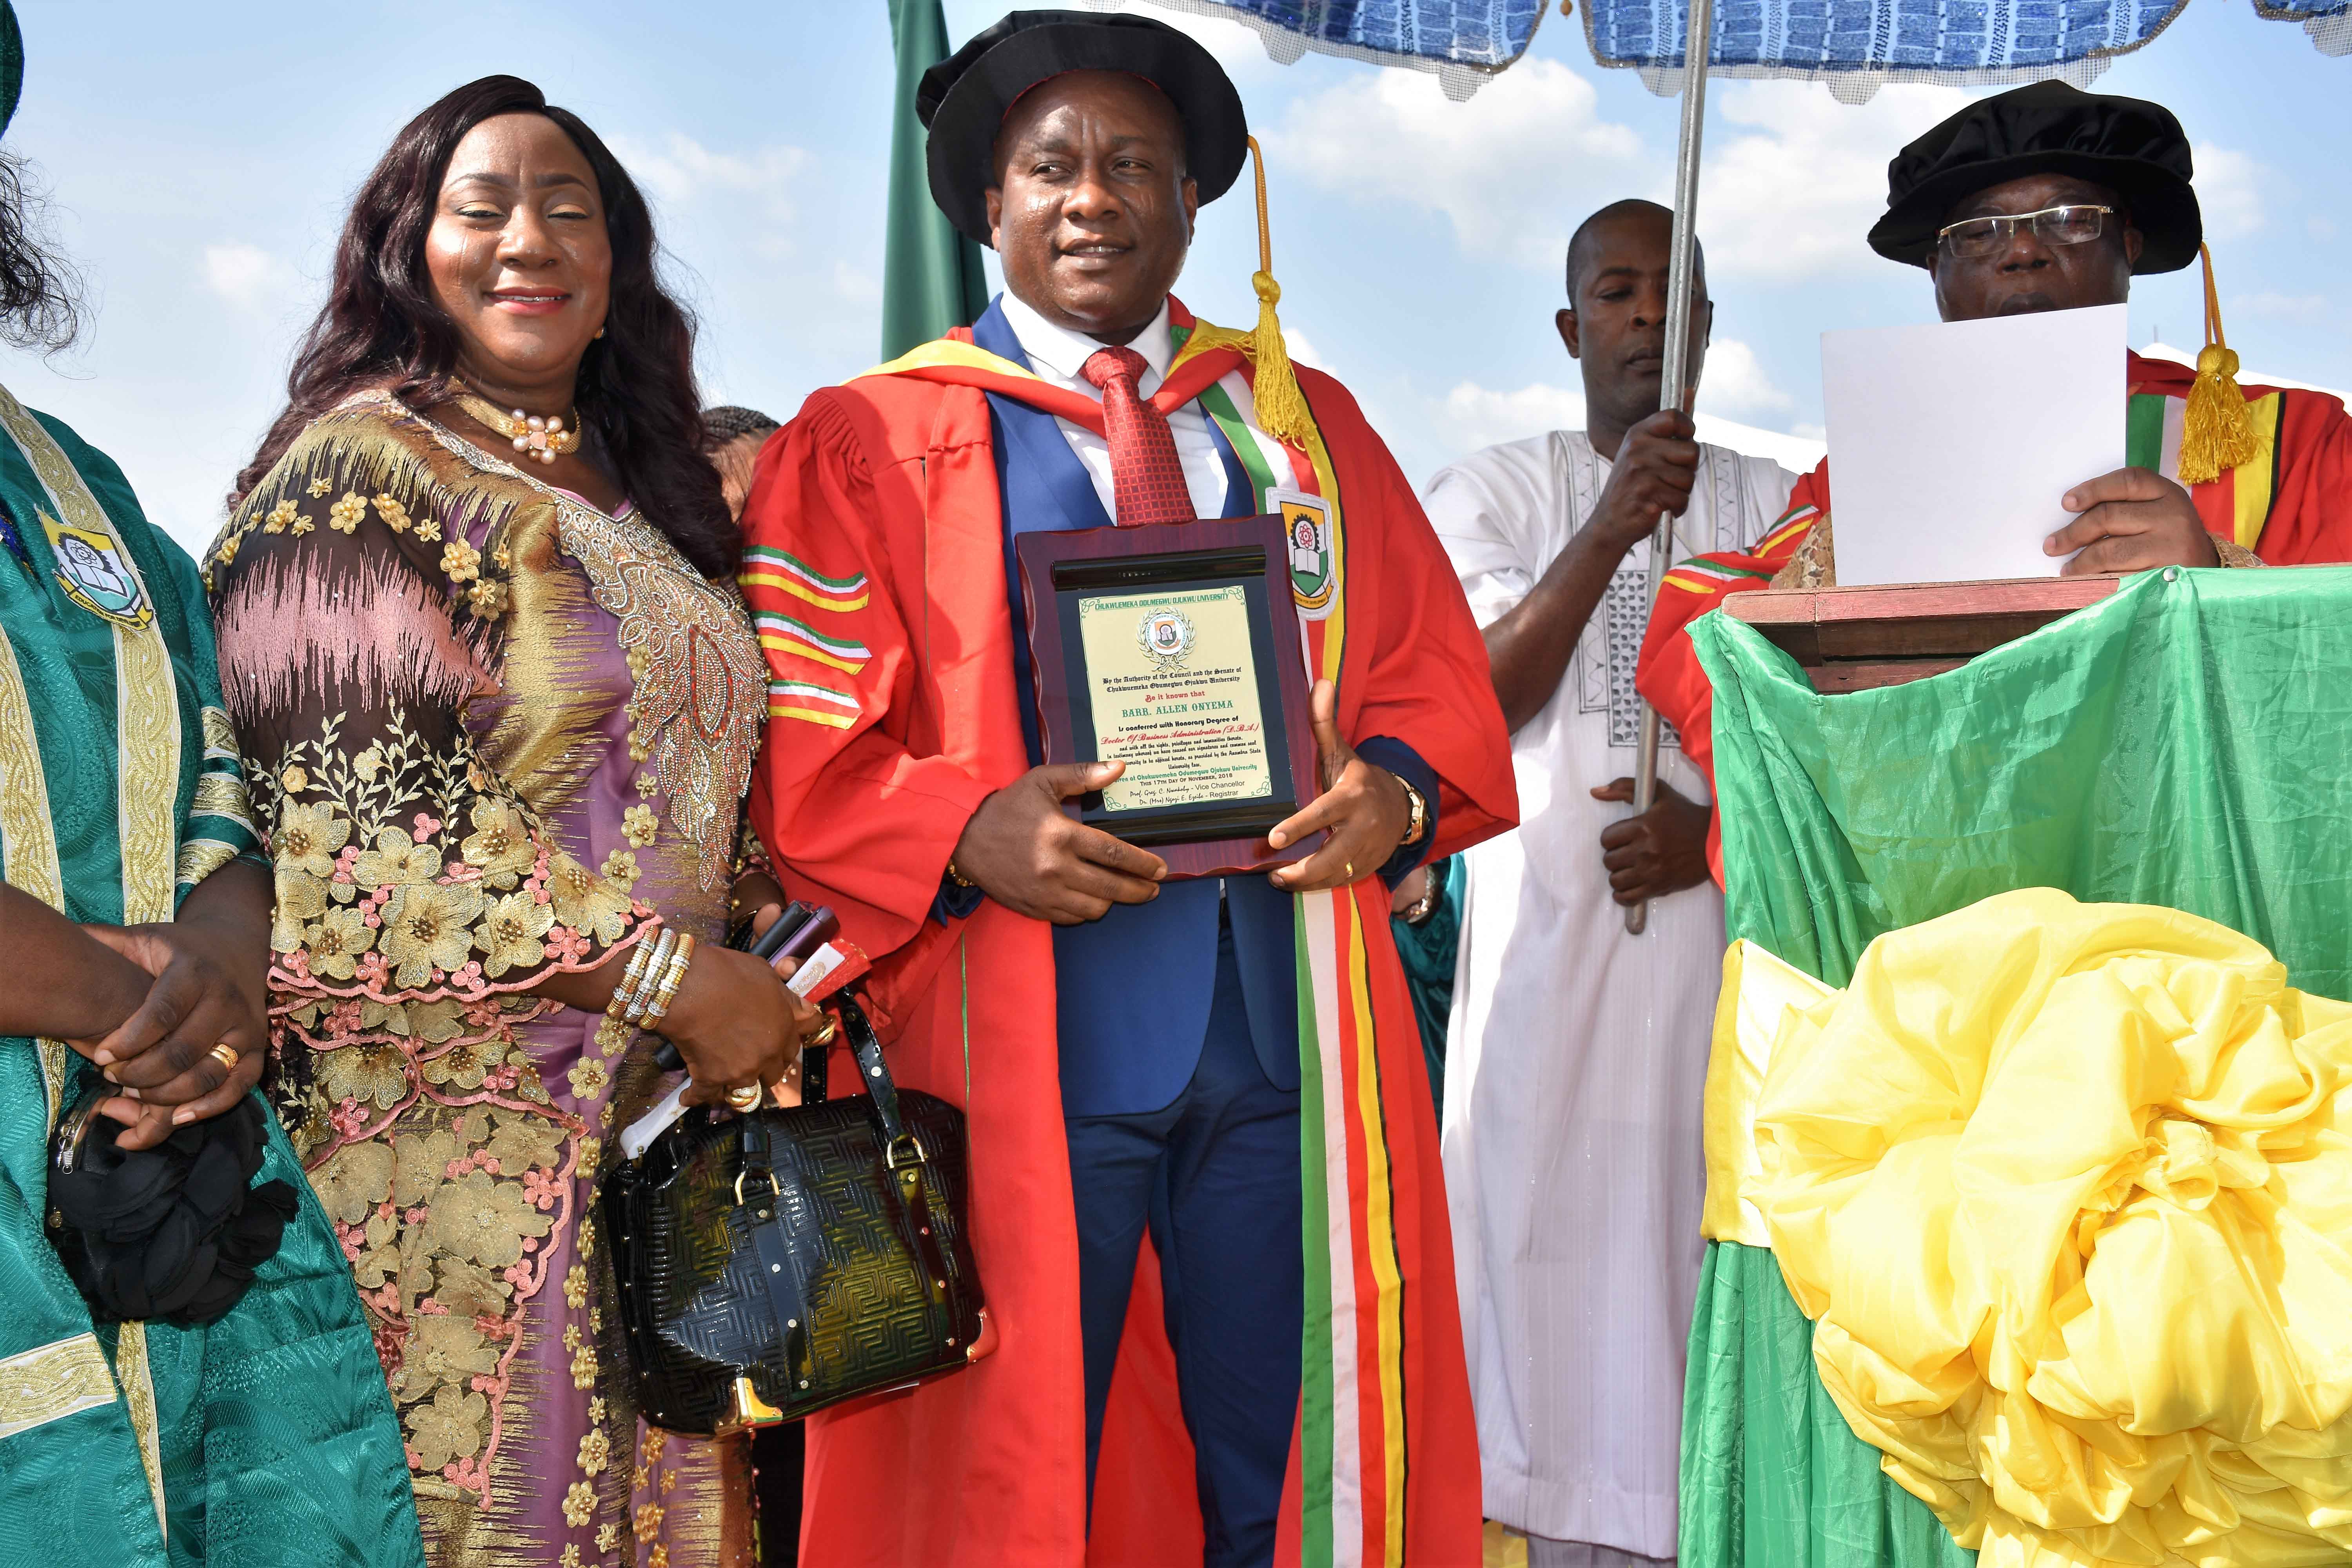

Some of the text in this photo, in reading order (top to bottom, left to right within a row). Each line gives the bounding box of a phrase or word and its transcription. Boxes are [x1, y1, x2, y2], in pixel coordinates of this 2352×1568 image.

[1095, 601, 1138, 610] CHUKWUEMEKA
[1140, 597, 1171, 606] ODUMEGWU
[1197, 593, 1229, 601] UNIVERSITY
[1107, 684, 1148, 693] Chukwuemeka
[1122, 700, 1233, 717] BARR. ALLEN ONYEMA
[1170, 728, 1221, 738] Administration
[1223, 723, 1259, 735] (D.B.A.)
[1172, 739, 1192, 748] privileges
[1137, 771, 1177, 780] Chukwuemeka
[1211, 780, 1245, 789] Chancellor
[1210, 790, 1238, 798] Registrar
